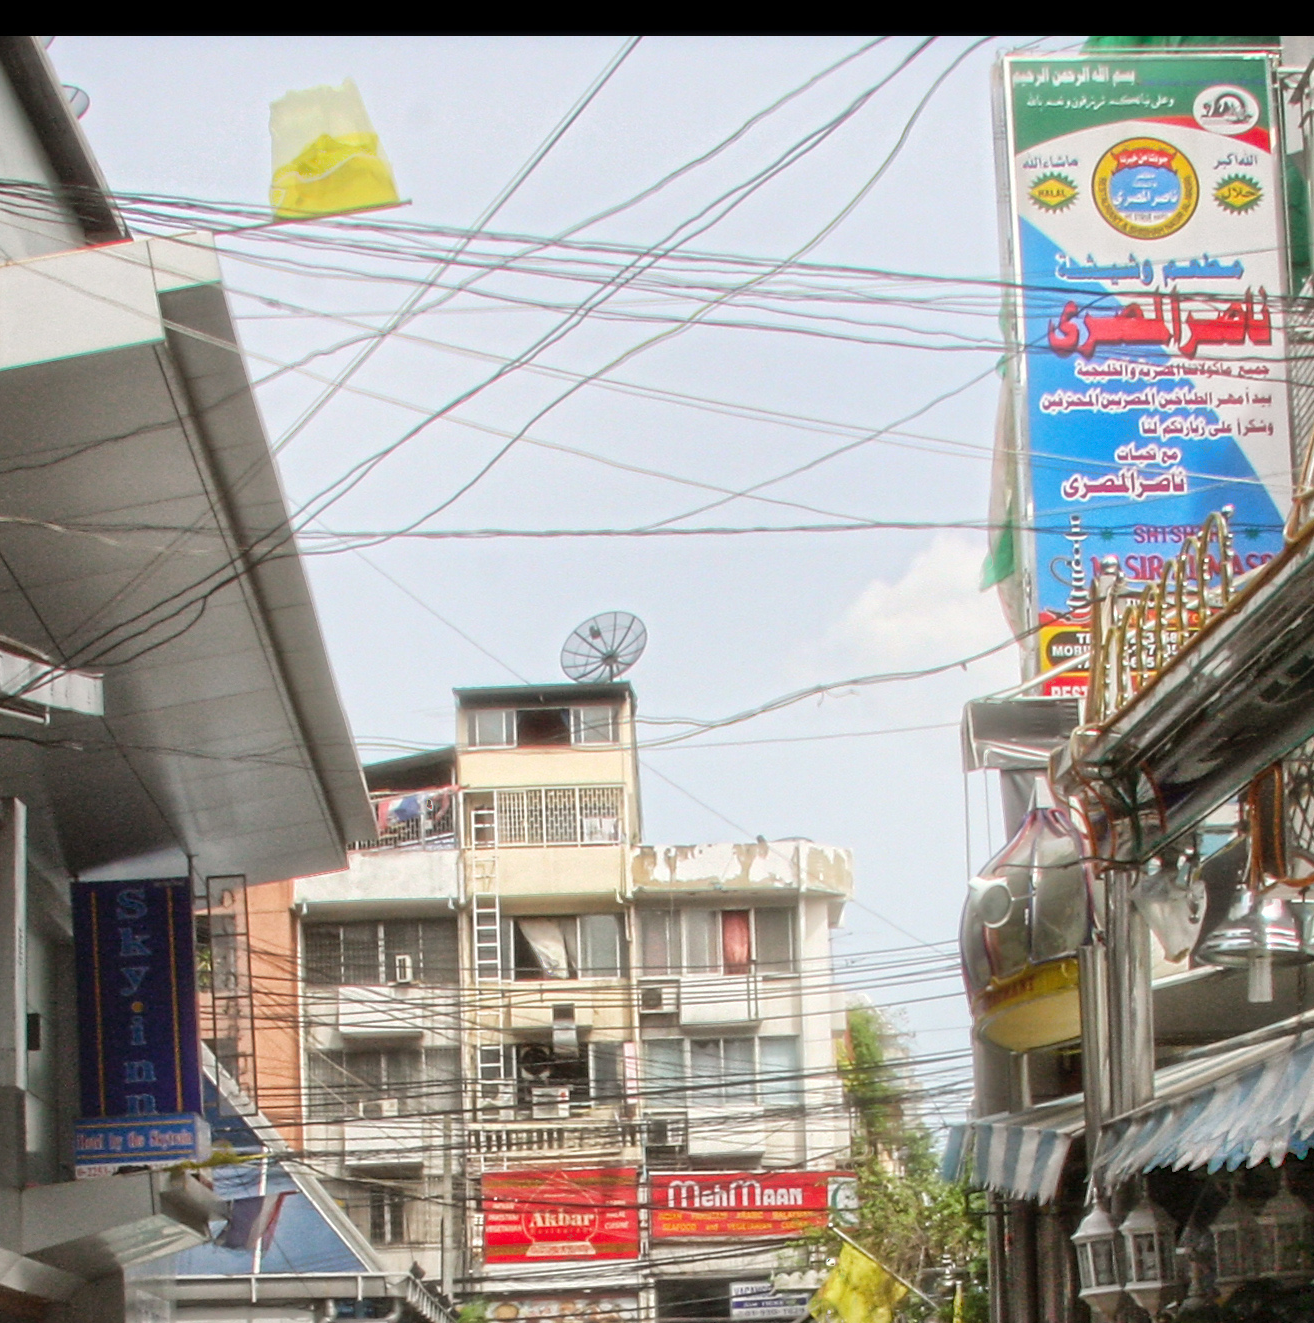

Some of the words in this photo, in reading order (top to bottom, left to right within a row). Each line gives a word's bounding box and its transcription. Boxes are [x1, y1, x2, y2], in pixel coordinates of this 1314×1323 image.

[1012, 66, 1050, 87] الرحيم
[1052, 65, 1090, 87] الرحمن
[1091, 64, 1110, 82] الله
[1112, 68, 1135, 87] بسم
[1037, 187, 1067, 198] HALAL
[1221, 186, 1257, 201] حلال
[1056, 252, 1153, 285] وشيشة
[1163, 252, 1244, 288] مطعم
[1178, 286, 1272, 360] ناصر
[1160, 446, 1180, 464] مع
[1136, 468, 1187, 498] ناصر
[115, 888, 154, 997] Sky
[528, 1209, 596, 1228] Akbar
